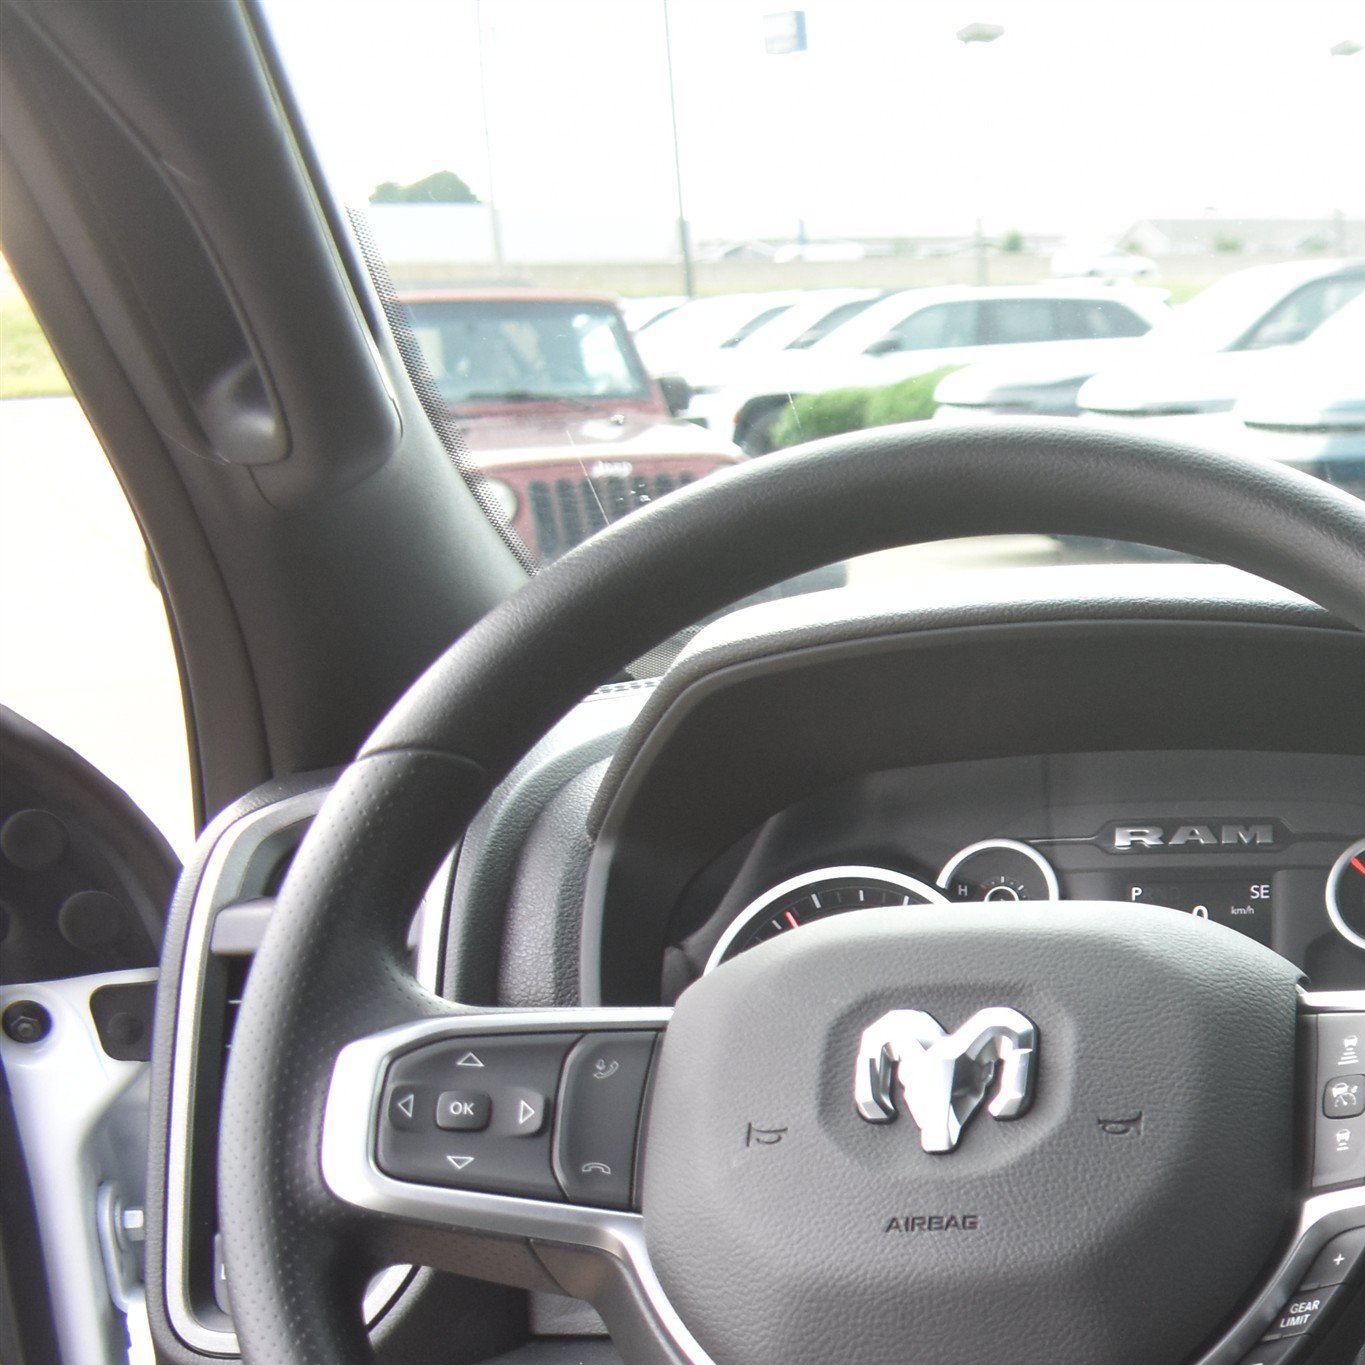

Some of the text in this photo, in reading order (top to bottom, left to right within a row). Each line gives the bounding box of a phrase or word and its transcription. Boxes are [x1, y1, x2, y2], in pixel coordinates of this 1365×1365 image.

[1114, 825, 1273, 849] RAM
[958, 885, 968, 896] H
[1131, 887, 1143, 901] P
[1250, 884, 1270, 899] SE
[1231, 905, 1255, 916] km/h
[450, 1101, 474, 1116] OK
[885, 1215, 979, 1232] AIRBAG
[1290, 1300, 1320, 1314] GEAR
[1280, 1314, 1311, 1328] LIMIT
